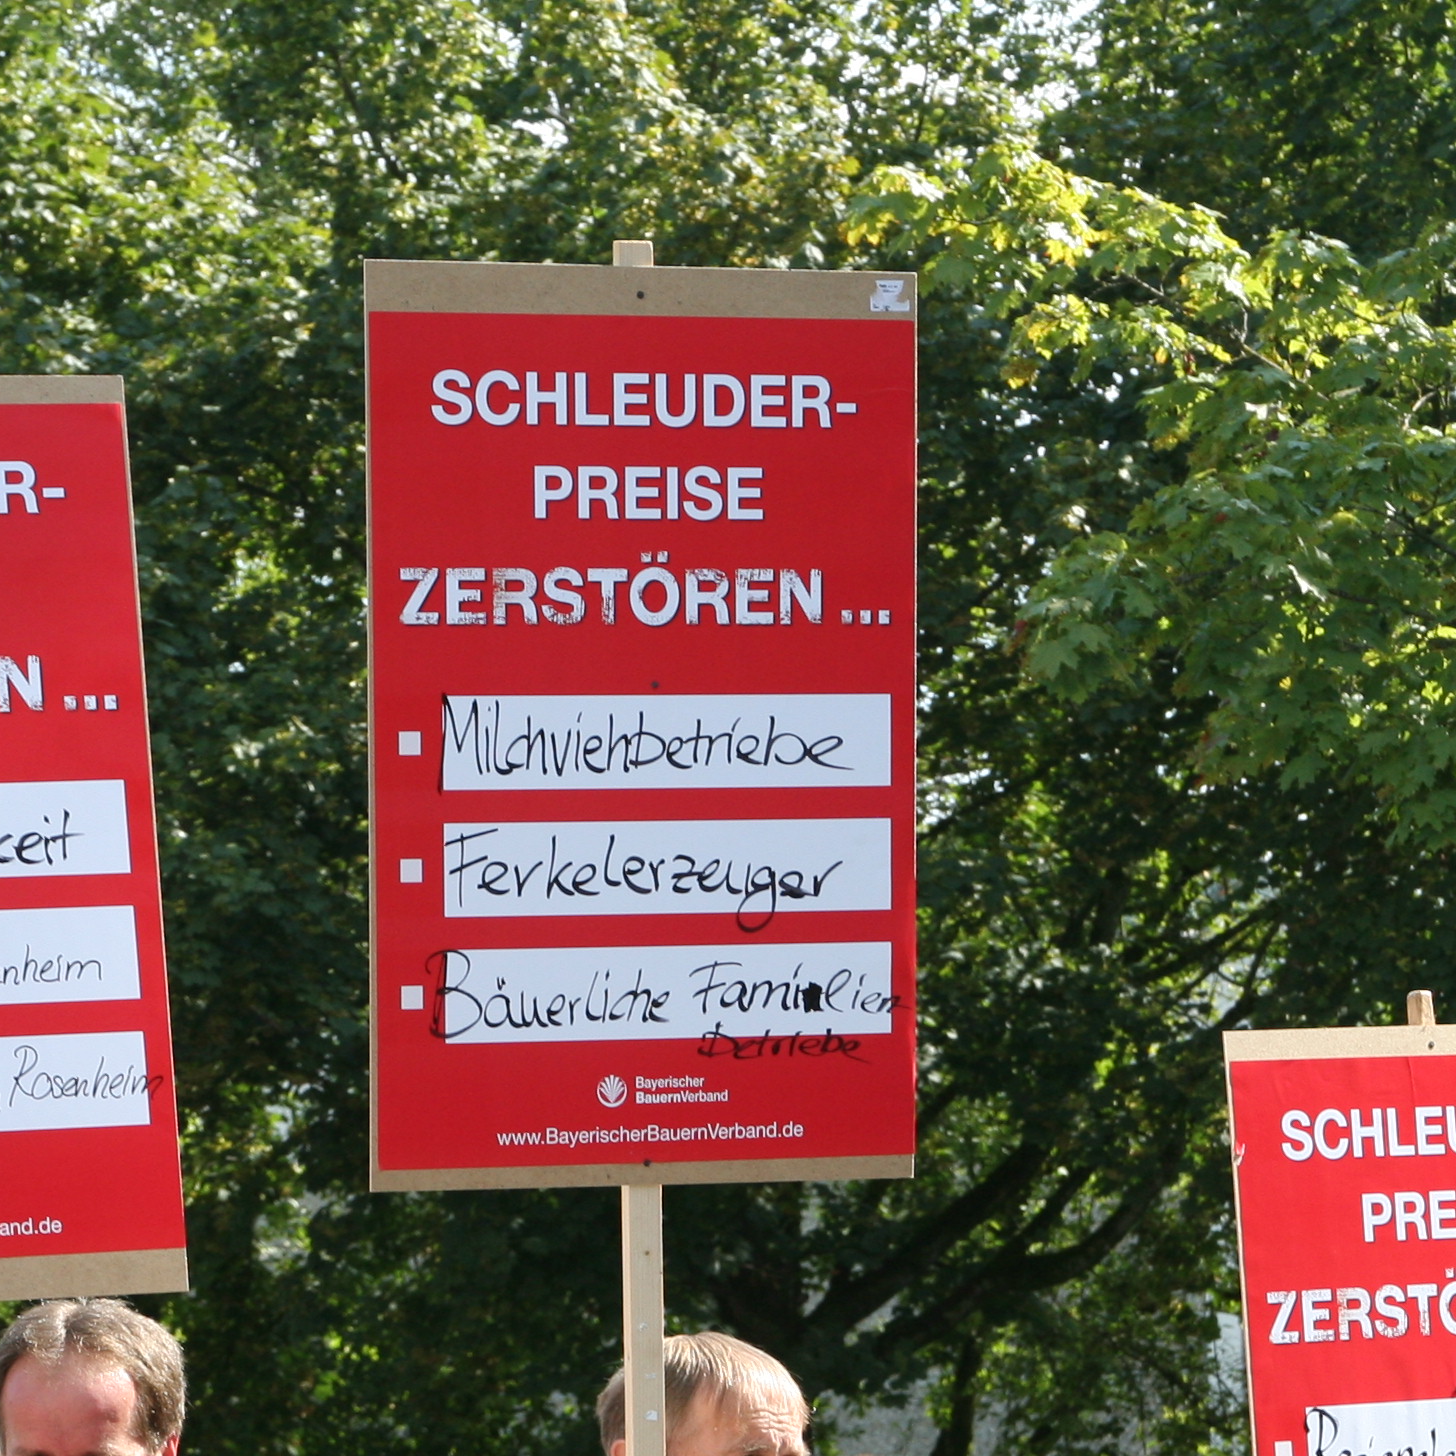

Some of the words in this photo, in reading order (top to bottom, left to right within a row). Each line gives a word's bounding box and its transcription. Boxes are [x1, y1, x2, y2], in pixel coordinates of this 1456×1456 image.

[431, 369, 857, 429] SCHLEUDER-
[533, 465, 765, 521] PREISE
[438, 692, 854, 796] Milchviehbetriebe
[444, 828, 842, 932] Ferkelerzeuger
[425, 949, 670, 1039] Bäuerliche
[9, 1045, 165, 1107] Rosenheim
[635, 1075, 705, 1091] Bayerischer
[635, 1089, 729, 1105] BauernVerband
[497, 1121, 805, 1148] www.BayerischerBauernVerband.de
